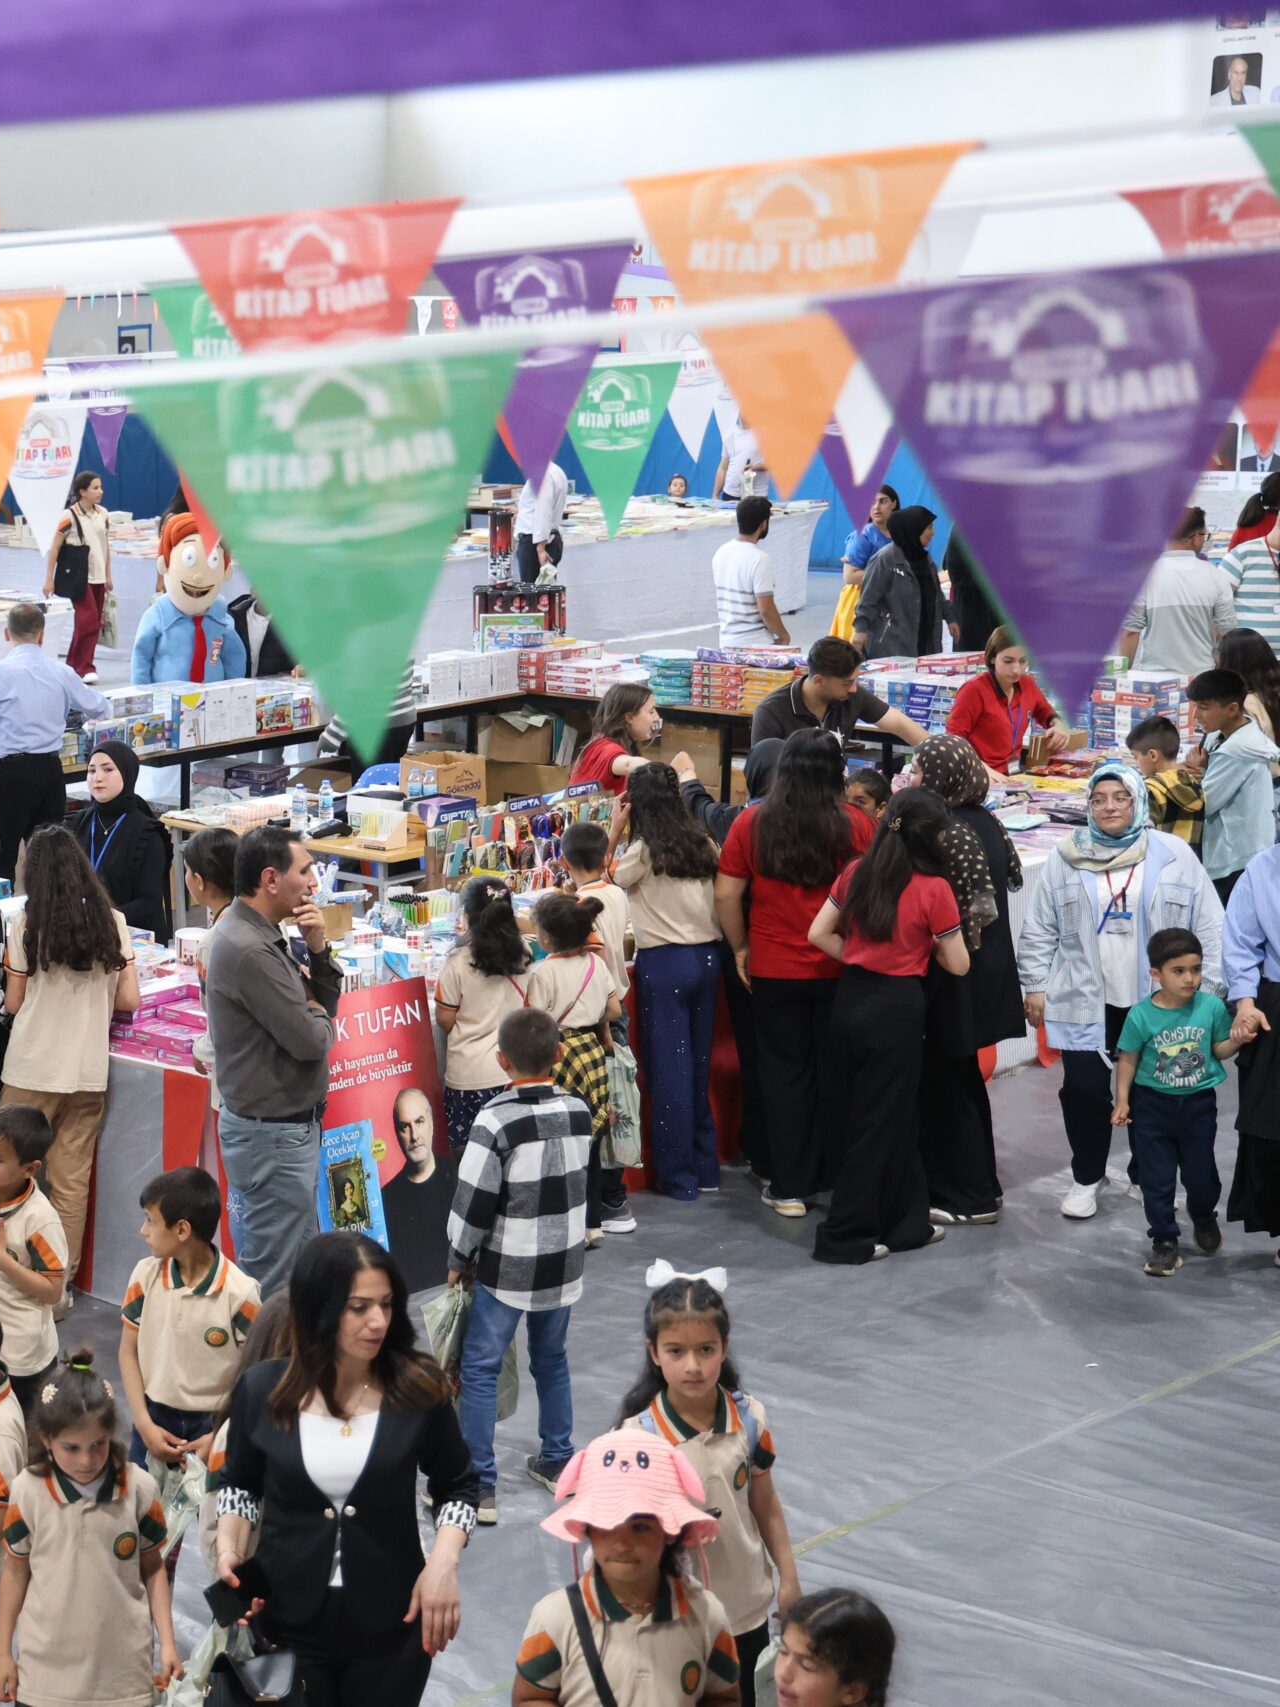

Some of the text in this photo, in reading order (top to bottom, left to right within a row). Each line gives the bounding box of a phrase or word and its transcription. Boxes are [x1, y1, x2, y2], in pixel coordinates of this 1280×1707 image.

[688, 231, 878, 273] KİTAP FUARI
[234, 274, 390, 319] KİTAP FUARI
[925, 360, 1199, 425] KİTAP FUARI
[577, 408, 650, 428] KİTAP FUARI
[17, 446, 72, 461] İTAP FUARI
[227, 430, 457, 492] KİTAP FUARI
[568, 783, 599, 797] GIPTA
[510, 798, 540, 812] GIPTA
[353, 999, 421, 1036] TUFAN
[1154, 1026, 1205, 1048] MONSTER
[344, 1051, 384, 1071] hayattan
[386, 1048, 398, 1060] da
[357, 1073, 367, 1084] de
[369, 1061, 413, 1081] büyüktür
[1154, 1067, 1206, 1088] MACHINE!
[321, 1130, 360, 1147] Gece Açan
[327, 1143, 357, 1159] Çiçekler
